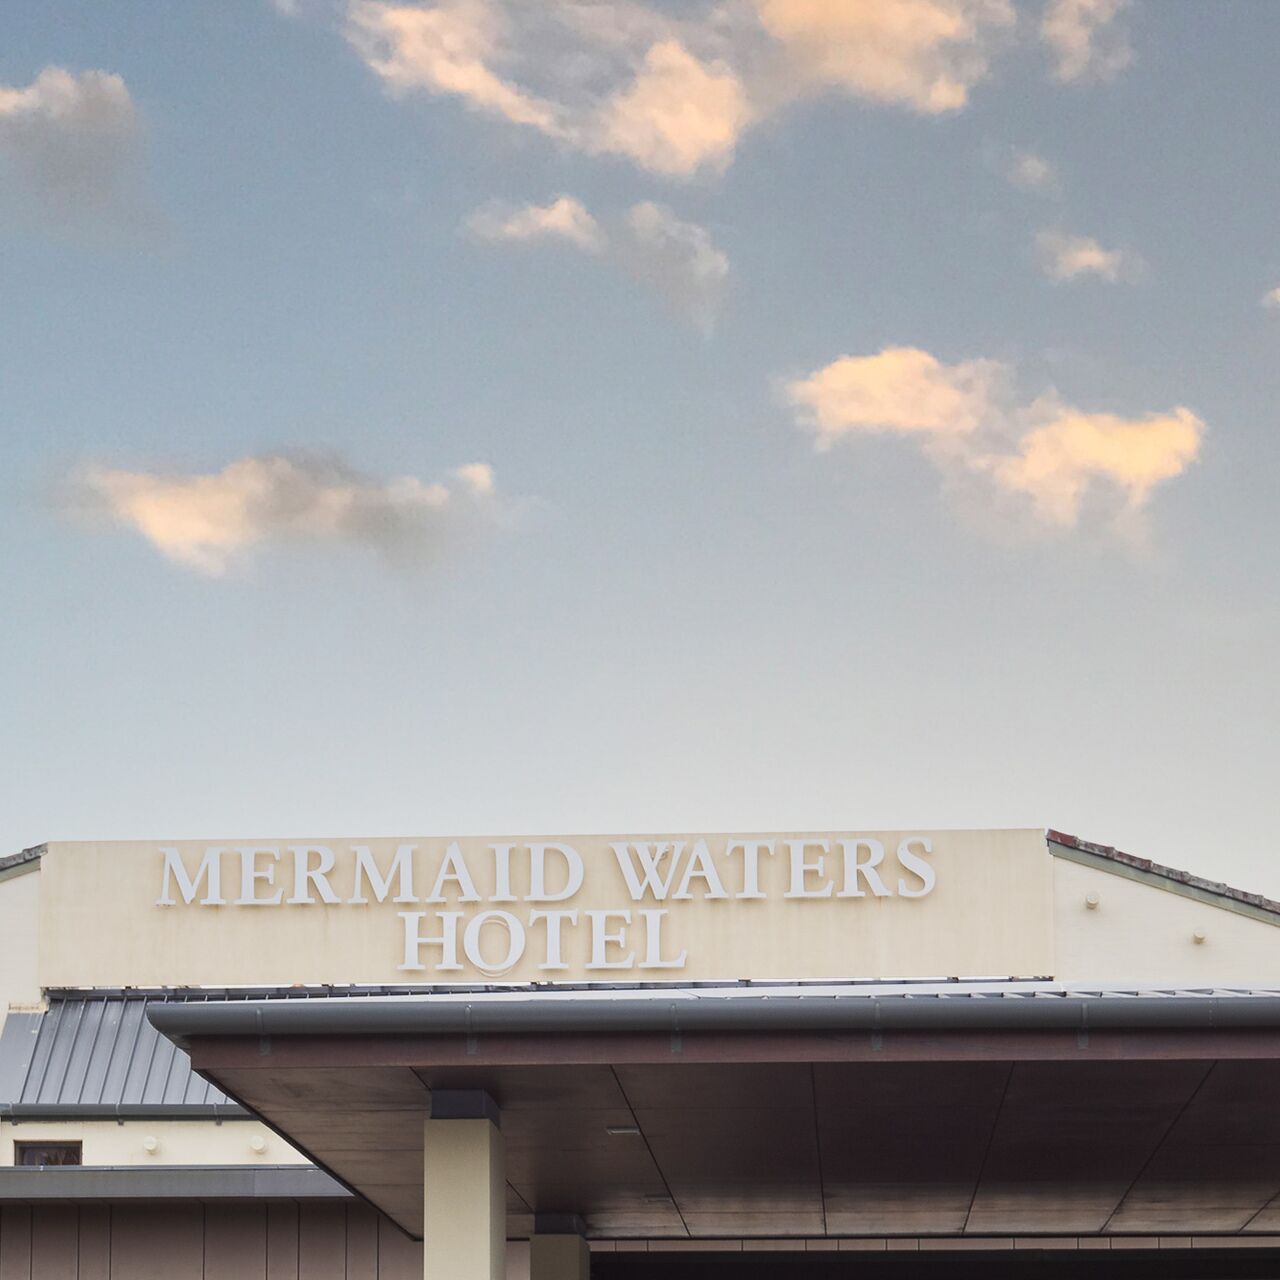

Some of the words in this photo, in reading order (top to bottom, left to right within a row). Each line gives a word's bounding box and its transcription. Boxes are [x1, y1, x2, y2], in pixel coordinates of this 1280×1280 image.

[156, 841, 584, 906] MERMAID
[608, 836, 937, 901] WATERS
[397, 908, 688, 972] HOTEL
